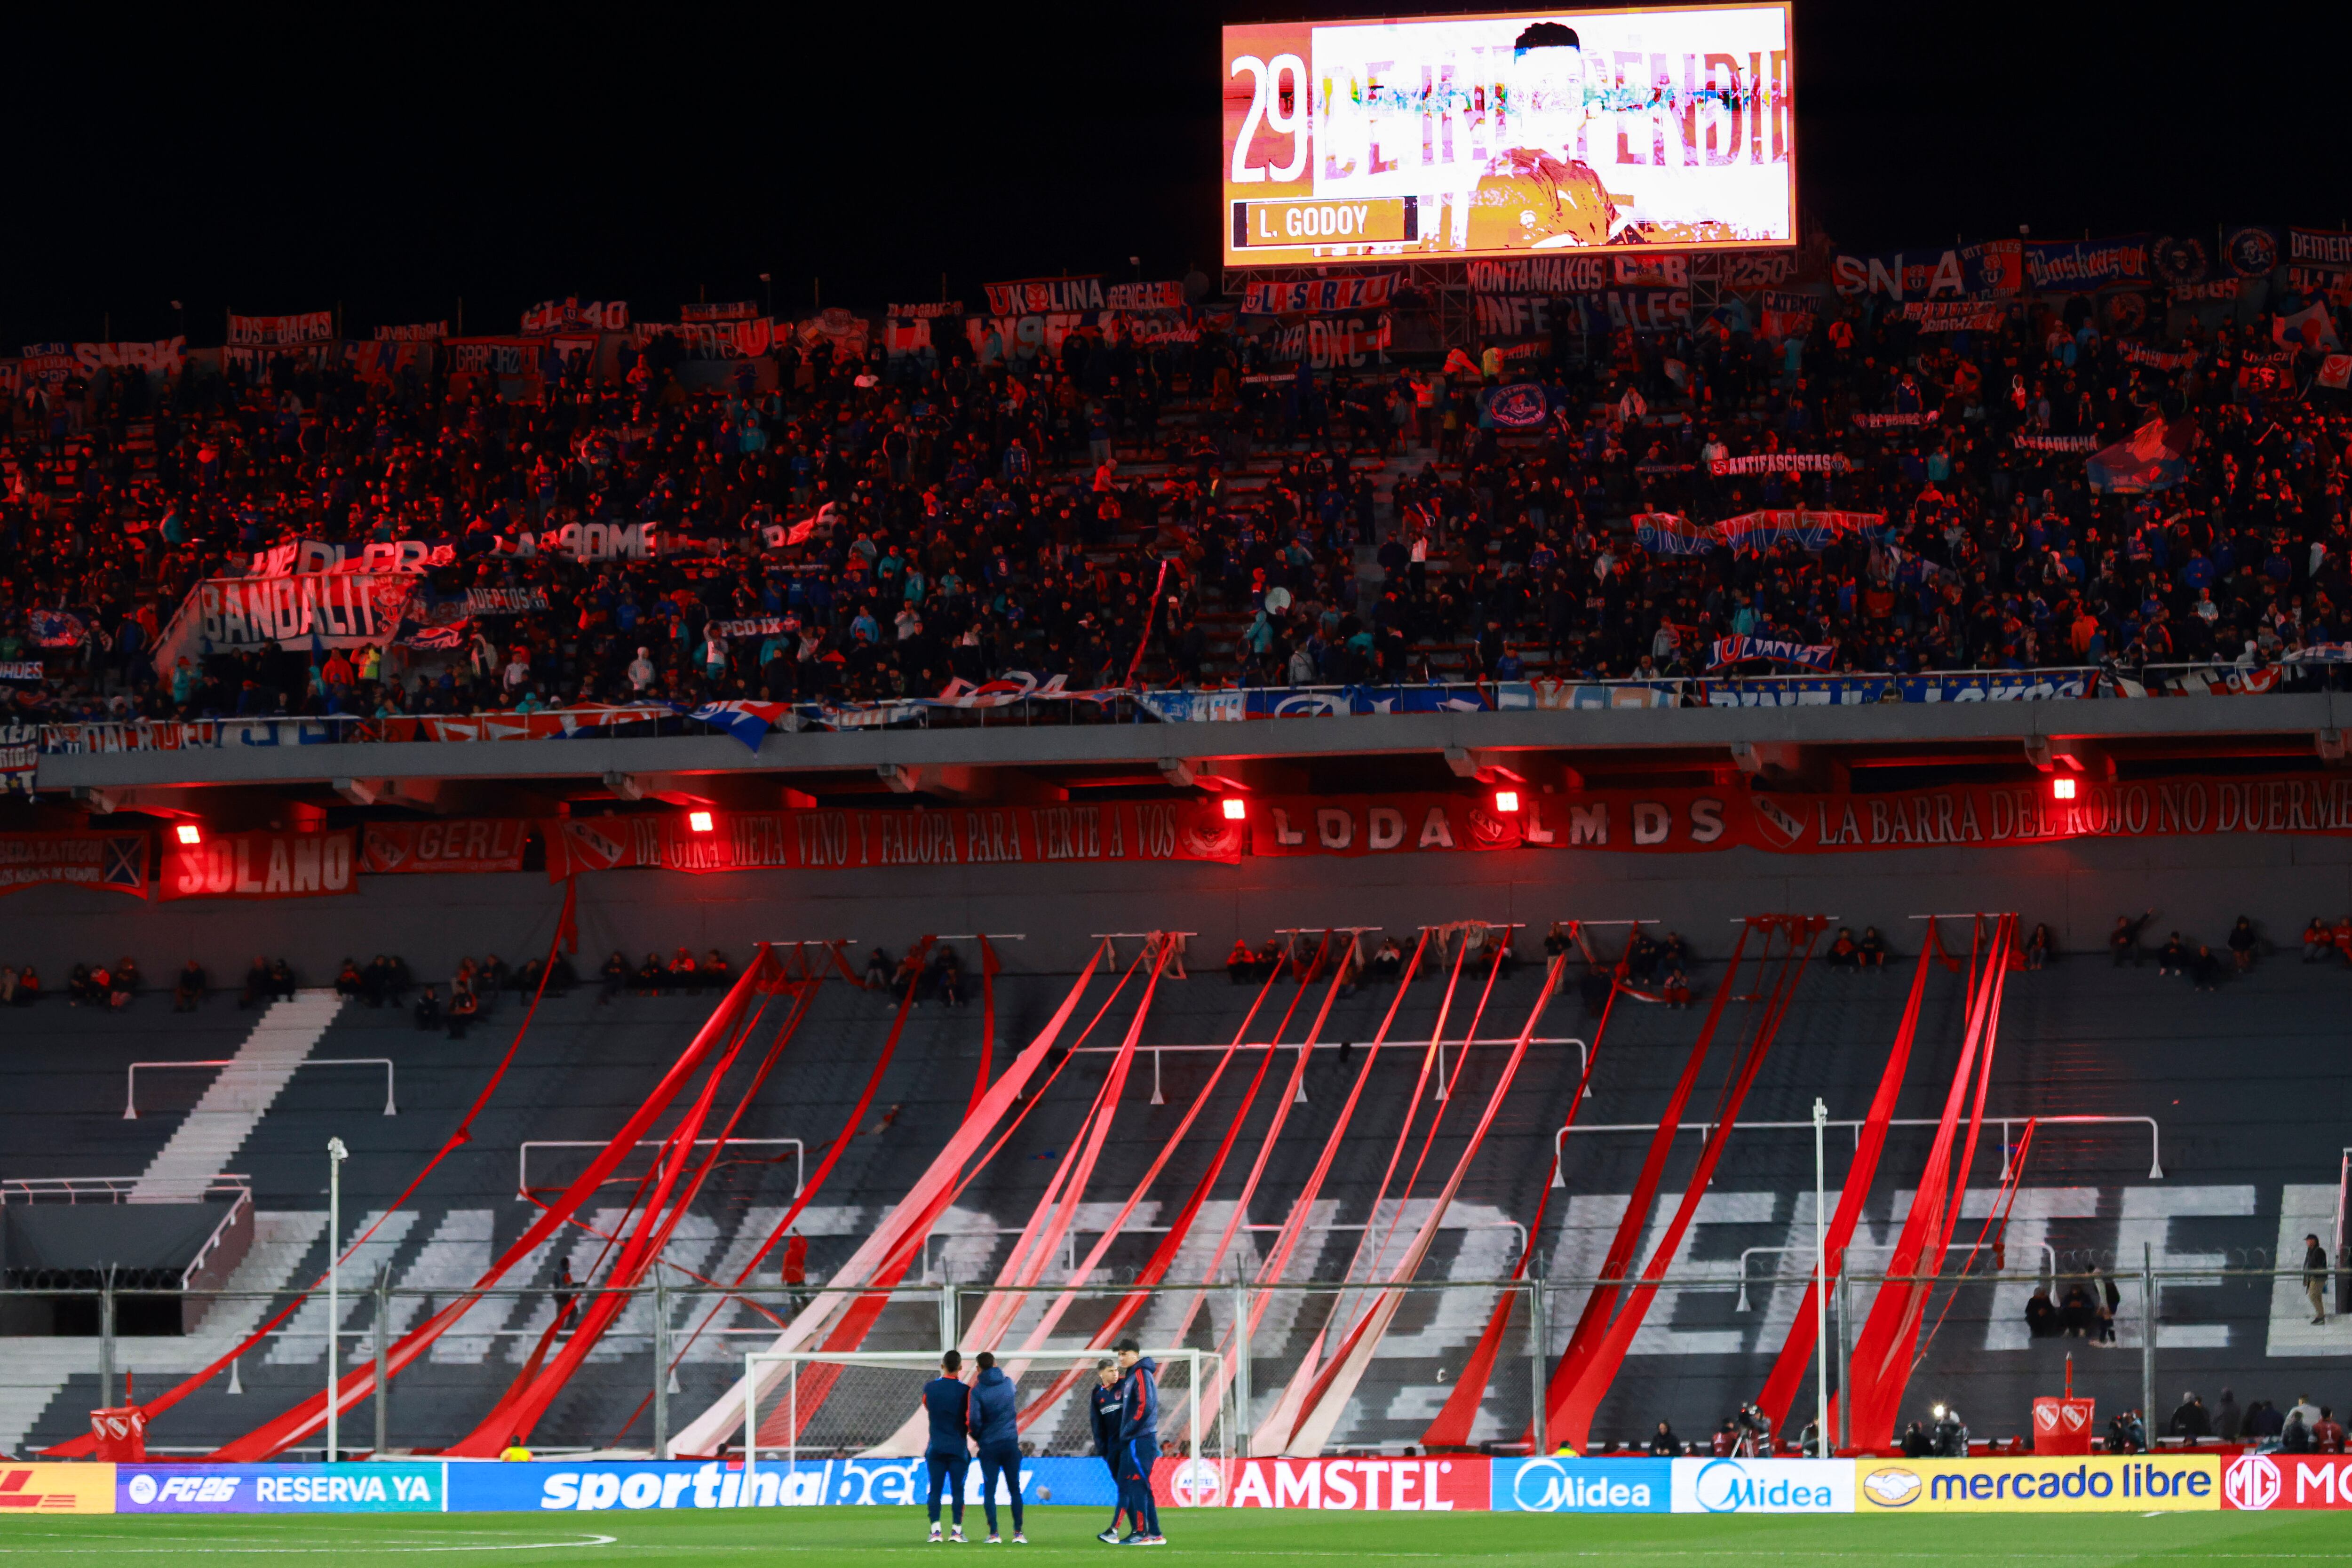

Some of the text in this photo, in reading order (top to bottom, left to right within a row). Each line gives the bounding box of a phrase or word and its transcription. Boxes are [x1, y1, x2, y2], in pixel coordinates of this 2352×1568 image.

[1231, 53, 1308, 183] 29
[1260, 205, 1368, 238] L. GODOY
[1466, 257, 1603, 293] MONTANIAKOS
[1476, 291, 1692, 335] INFEALES
[1729, 454, 1831, 476] ANTIFASCISTAS
[1817, 799, 1863, 845] LA
[1869, 791, 1984, 845] BARRA
[1989, 788, 2057, 841] DEL
[2065, 785, 2150, 836] ROJO
[2157, 781, 2208, 833] NO
[416, 820, 525, 860] GERLI
[633, 821, 661, 866] DE
[730, 815, 787, 867] META
[796, 812, 849, 866] VINO
[858, 813, 872, 865] Y
[880, 813, 959, 864] FALOPA
[967, 811, 1023, 862] PARA
[1032, 807, 1101, 860] VERTE
[1108, 806, 1125, 857] A
[1136, 804, 1176, 858] VOS
[177, 834, 351, 894] SOLANO
[257, 1476, 431, 1502] RESERVA YA
[1232, 1460, 1454, 1511] AMSTEL
[1534, 1476, 1650, 1507] Midea
[1717, 1478, 1832, 1507] Midea
[1930, 1463, 2212, 1500] mercado libre
[2230, 1459, 2277, 1507] MG
